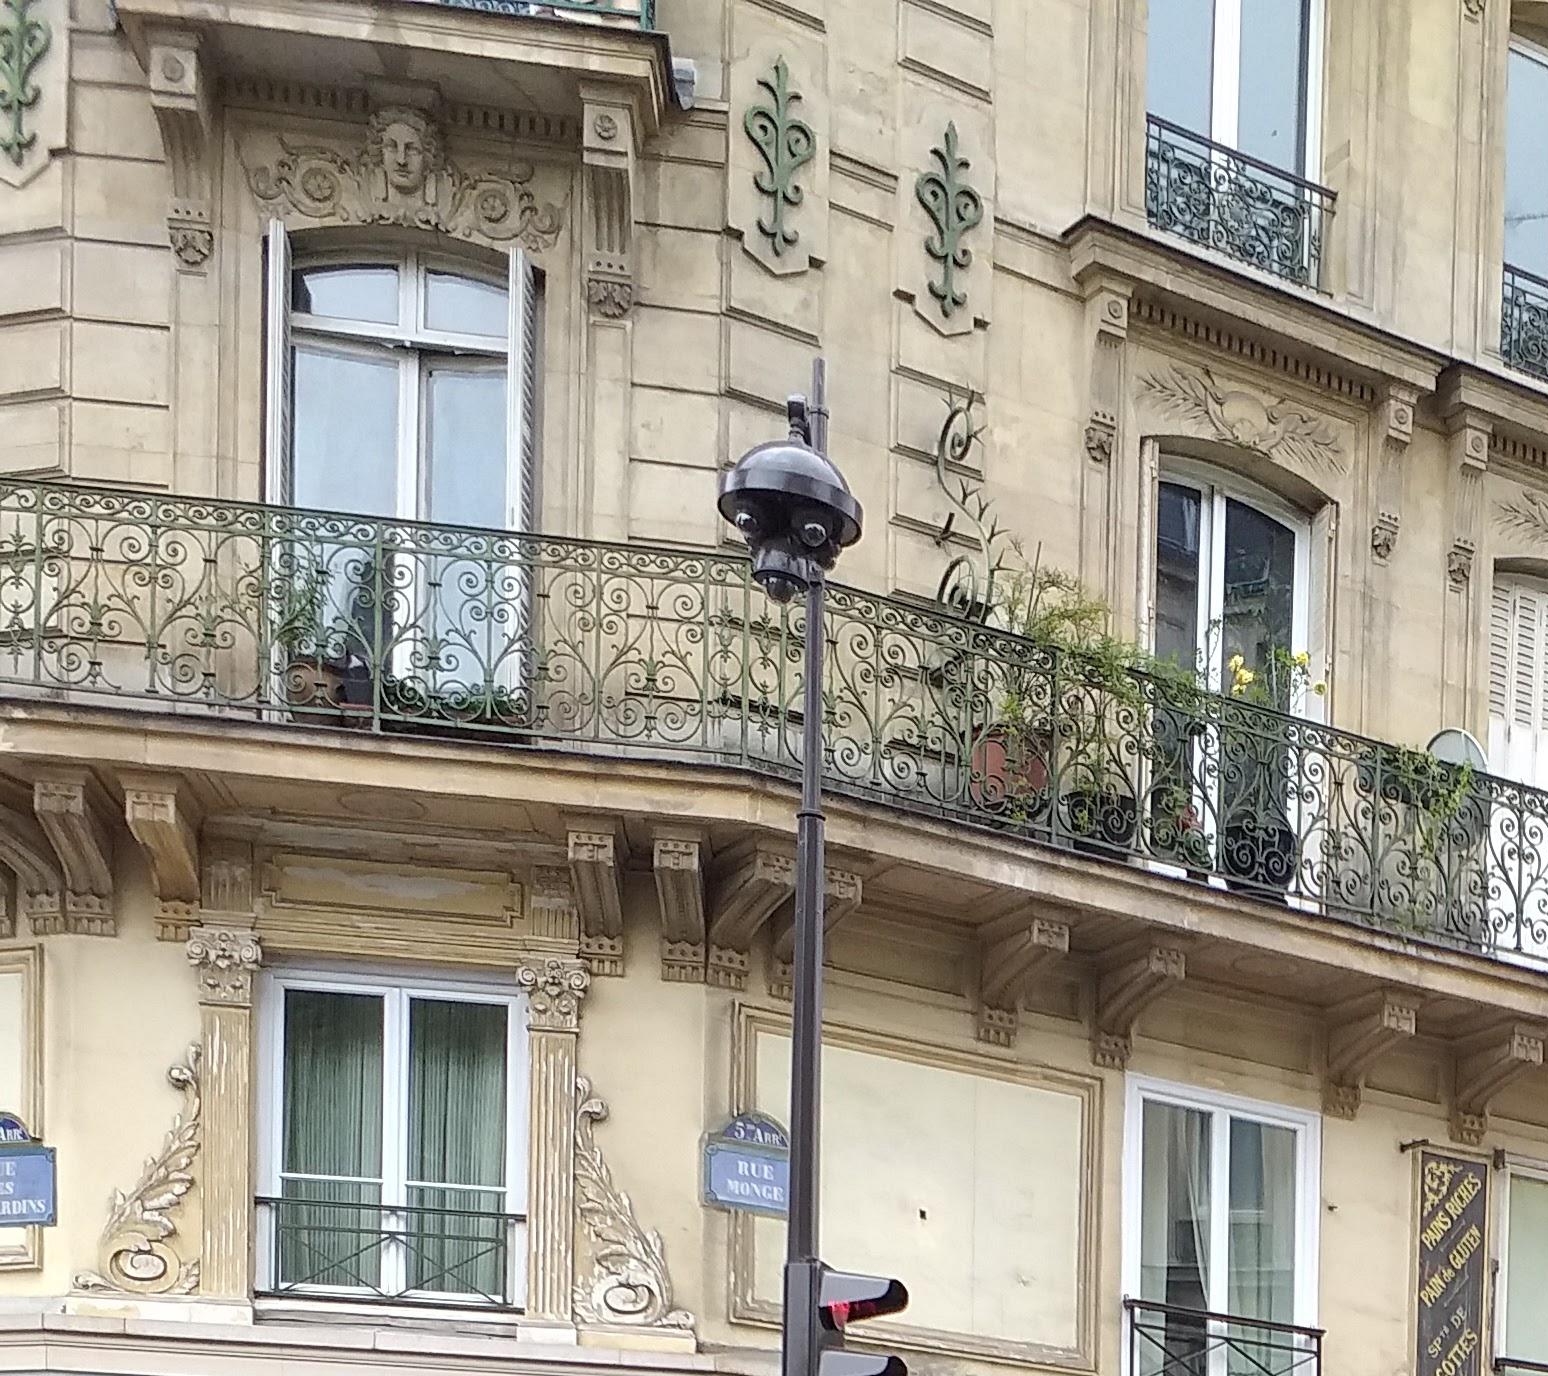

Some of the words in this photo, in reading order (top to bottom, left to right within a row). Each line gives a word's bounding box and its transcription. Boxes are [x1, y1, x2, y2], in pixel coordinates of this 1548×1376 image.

[726, 1178, 784, 1202] MONGE
[737, 1160, 774, 1180] RUE
[1421, 1210, 1453, 1252] PAINS
[1445, 1171, 1482, 1221] RICHES
[1419, 1272, 1447, 1308] PAIN
[1448, 1223, 1482, 1270] GLUTEN
